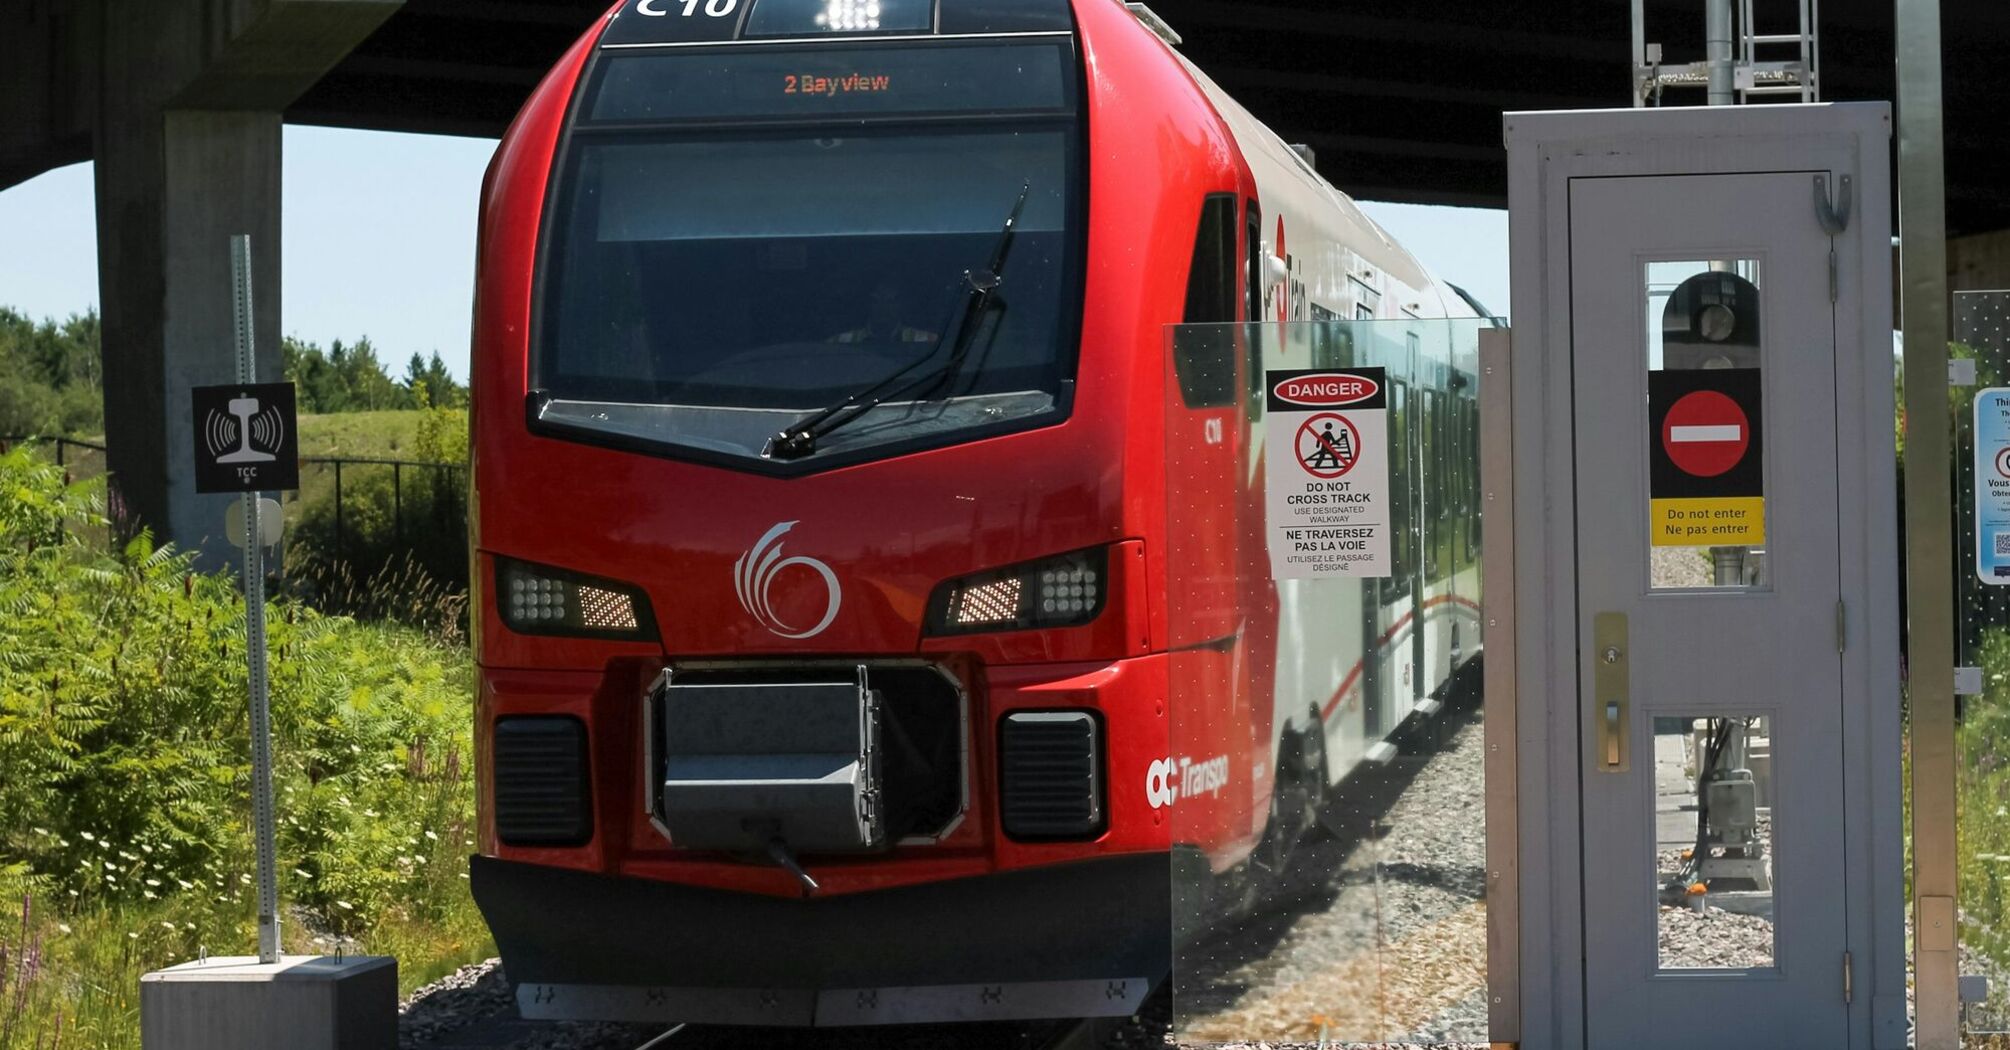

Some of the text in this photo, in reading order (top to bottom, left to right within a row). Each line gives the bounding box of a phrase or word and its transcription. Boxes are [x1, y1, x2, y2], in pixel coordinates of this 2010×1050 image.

[784, 72, 889, 97] 2 Bayview
[1288, 382, 1363, 397] DANGER
[1995, 397, 2010, 407] Thi
[236, 467, 257, 478] TCC
[1307, 481, 1351, 492] DO NOT
[1287, 493, 1371, 504] CROSS TRACK
[1294, 505, 1365, 515] USE DESIGNATED
[1668, 509, 1747, 519] Do not enter
[1309, 515, 1350, 523] WALKWAY
[1286, 528, 1374, 540] NE TRAVERSEZ
[1665, 525, 1750, 536] Ne pas entrer
[1295, 540, 1366, 551] PAS LA VOIE
[1287, 553, 1375, 563] UTILISEZ LE PASSAGE
[1312, 562, 1349, 572] DÉSIGNÉ
[1179, 754, 1228, 799] Transpo
